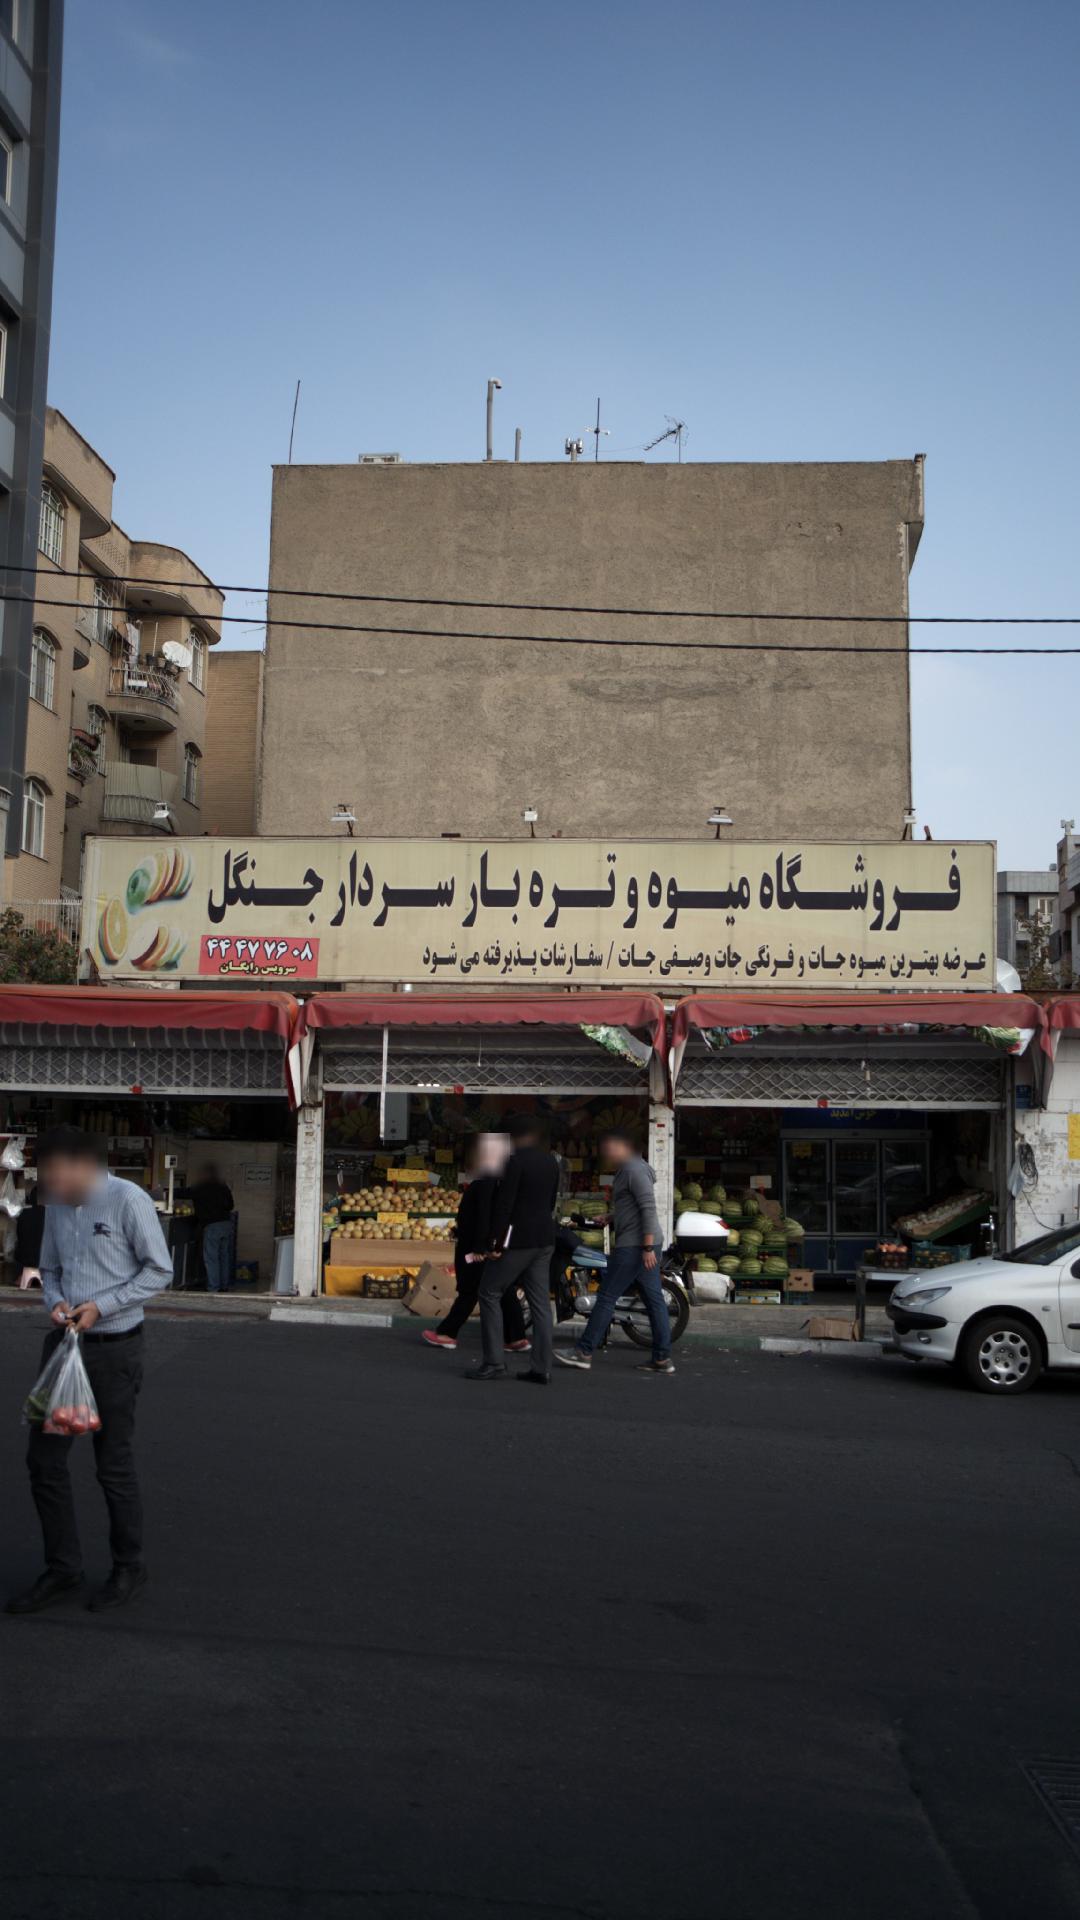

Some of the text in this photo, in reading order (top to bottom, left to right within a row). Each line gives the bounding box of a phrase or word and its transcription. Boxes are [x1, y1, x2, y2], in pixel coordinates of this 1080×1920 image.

[208, 849, 960, 930] فروشگاه میوه و تره بار سردار جنگل
[261, 964, 298, 976] سرویس
[483, 940, 537, 975] پذیرفته
[540, 941, 603, 974] سفارشات
[619, 943, 655, 974] جات
[715, 944, 741, 975] جات
[746, 943, 794, 977] فرنگی
[798, 955, 804, 978] و
[809, 945, 846, 976] جات
[850, 953, 885, 978] میوه
[890, 950, 938, 979] بهترین
[943, 947, 986, 979] عرضه
